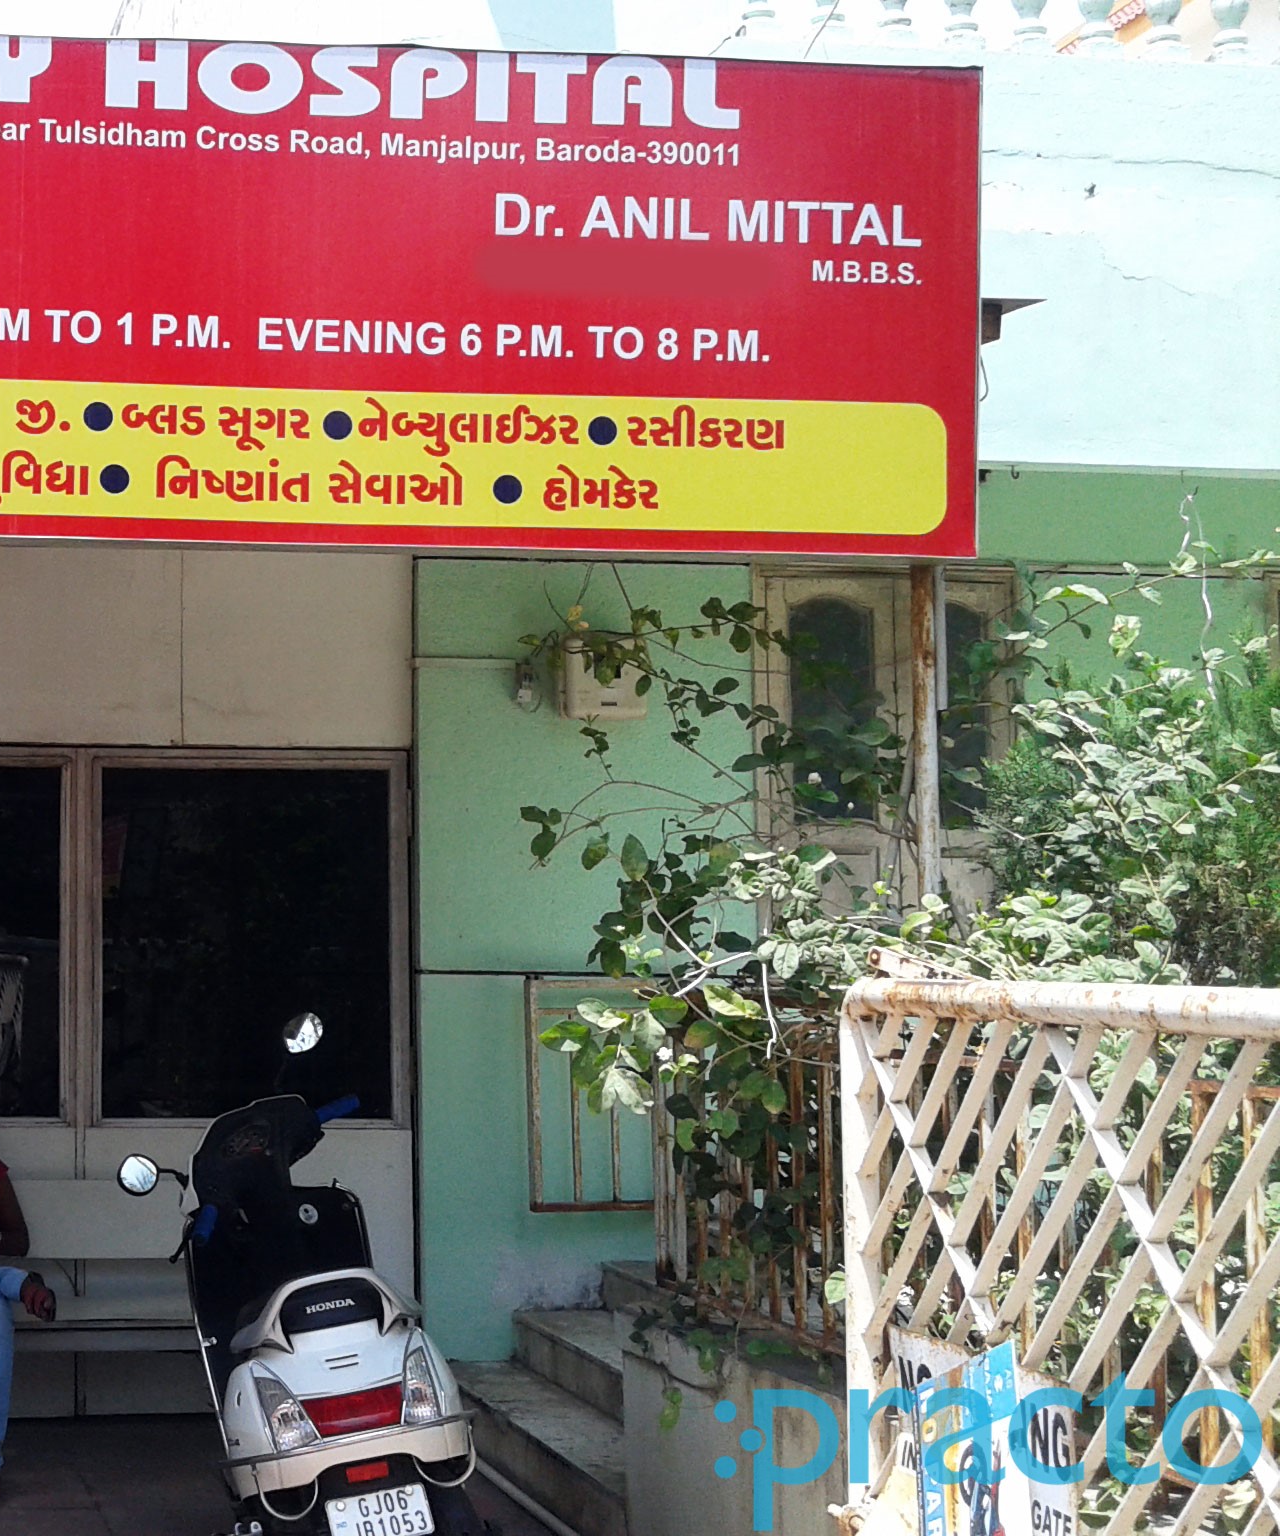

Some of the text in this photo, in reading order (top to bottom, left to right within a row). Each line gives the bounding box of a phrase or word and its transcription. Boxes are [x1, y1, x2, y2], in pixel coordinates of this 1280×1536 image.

[105, 39, 741, 130] HOSPITAL
[38, 118, 187, 149] Tulsidham
[196, 125, 280, 153] Cross
[288, 128, 371, 160] Road,
[380, 132, 526, 165] Manjalpur,
[535, 137, 739, 167] Baroda-390011
[494, 192, 922, 248] Dr. ANIL MITTAL
[812, 259, 922, 285] M.B.B.S.
[43, 309, 108, 345] TO
[122, 311, 135, 346] 1
[152, 313, 231, 349] P.M.
[258, 317, 446, 356] EVENING
[460, 323, 482, 357] 6
[496, 323, 574, 358] P.M.
[587, 325, 644, 360] TO
[657, 327, 679, 361] 8
[693, 328, 770, 363] P.M.
[15, 399, 71, 435] જી.
[121, 403, 206, 436] બ્લડ
[218, 406, 310, 452] સૂગર
[626, 404, 785, 451] રસીકરણ
[328, 459, 463, 506] સેવાઓ
[543, 463, 659, 512] હોમકેર
[305, 1298, 356, 1314] HONDA
[358, 1489, 410, 1518] GJ06
